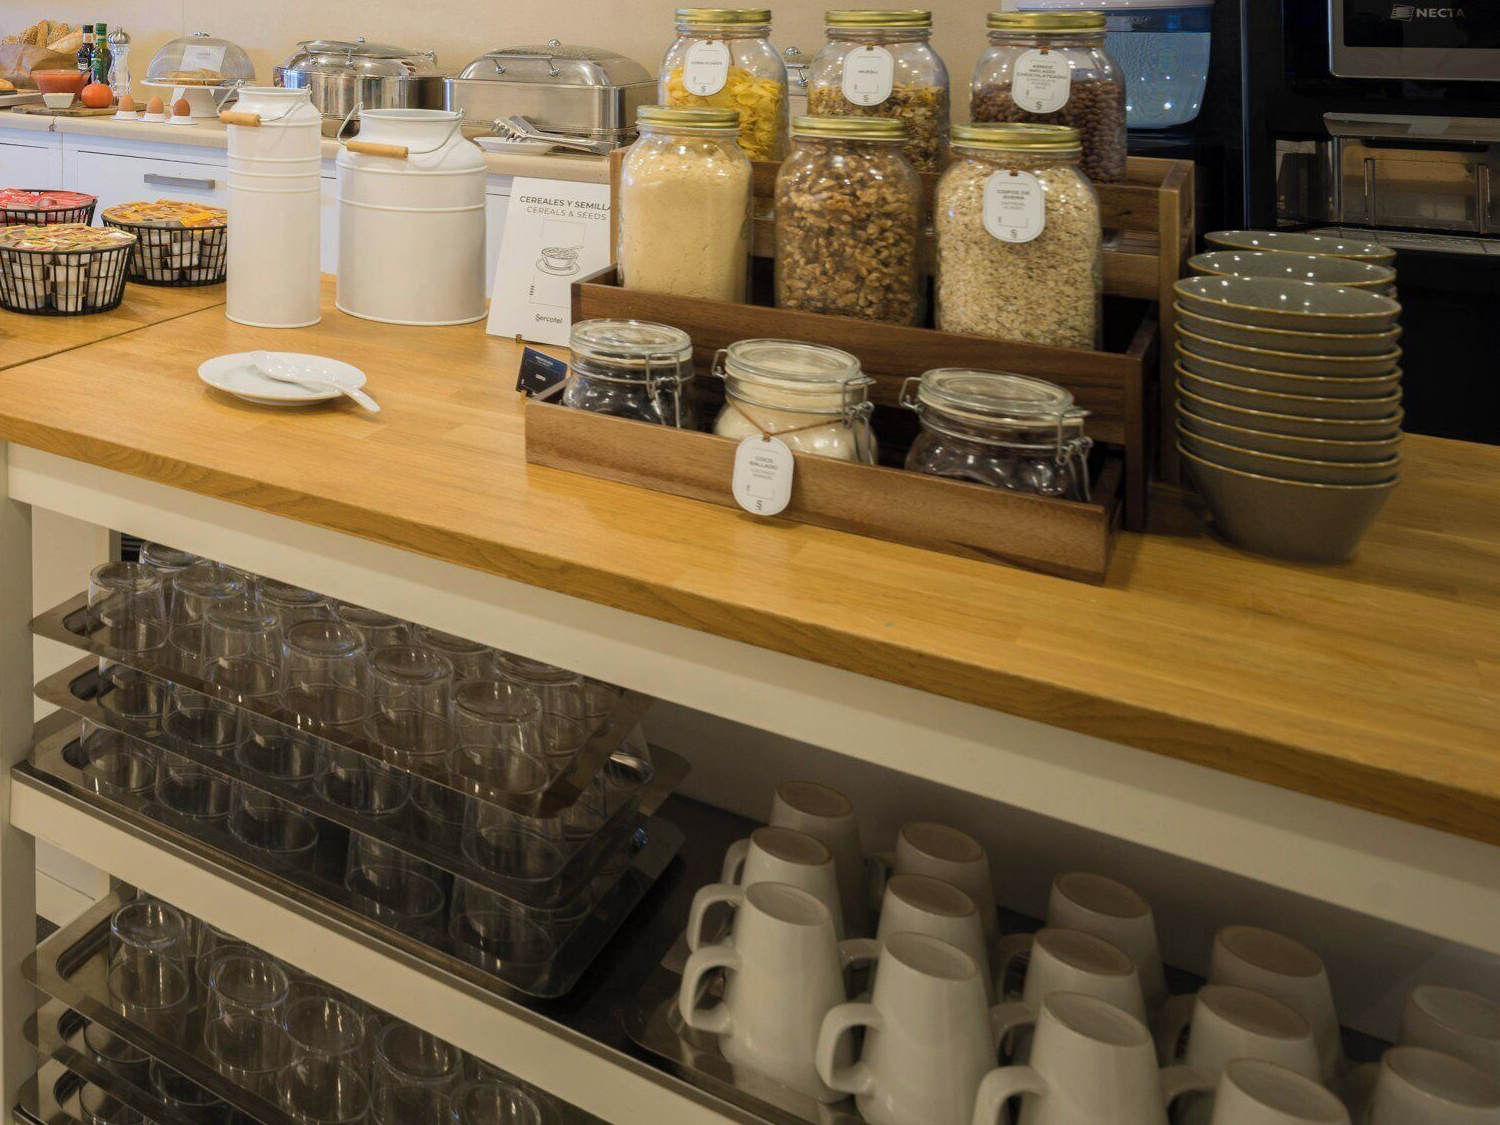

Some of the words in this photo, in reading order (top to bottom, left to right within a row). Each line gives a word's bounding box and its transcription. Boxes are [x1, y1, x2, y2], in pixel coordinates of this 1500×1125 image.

[1416, 7, 1466, 19] NECTA
[519, 195, 565, 207] CEREALES
[567, 200, 574, 208] Y
[526, 206, 566, 217] CEREALS
[576, 211, 607, 221] SEEDS
[535, 313, 563, 324] Sercotel
